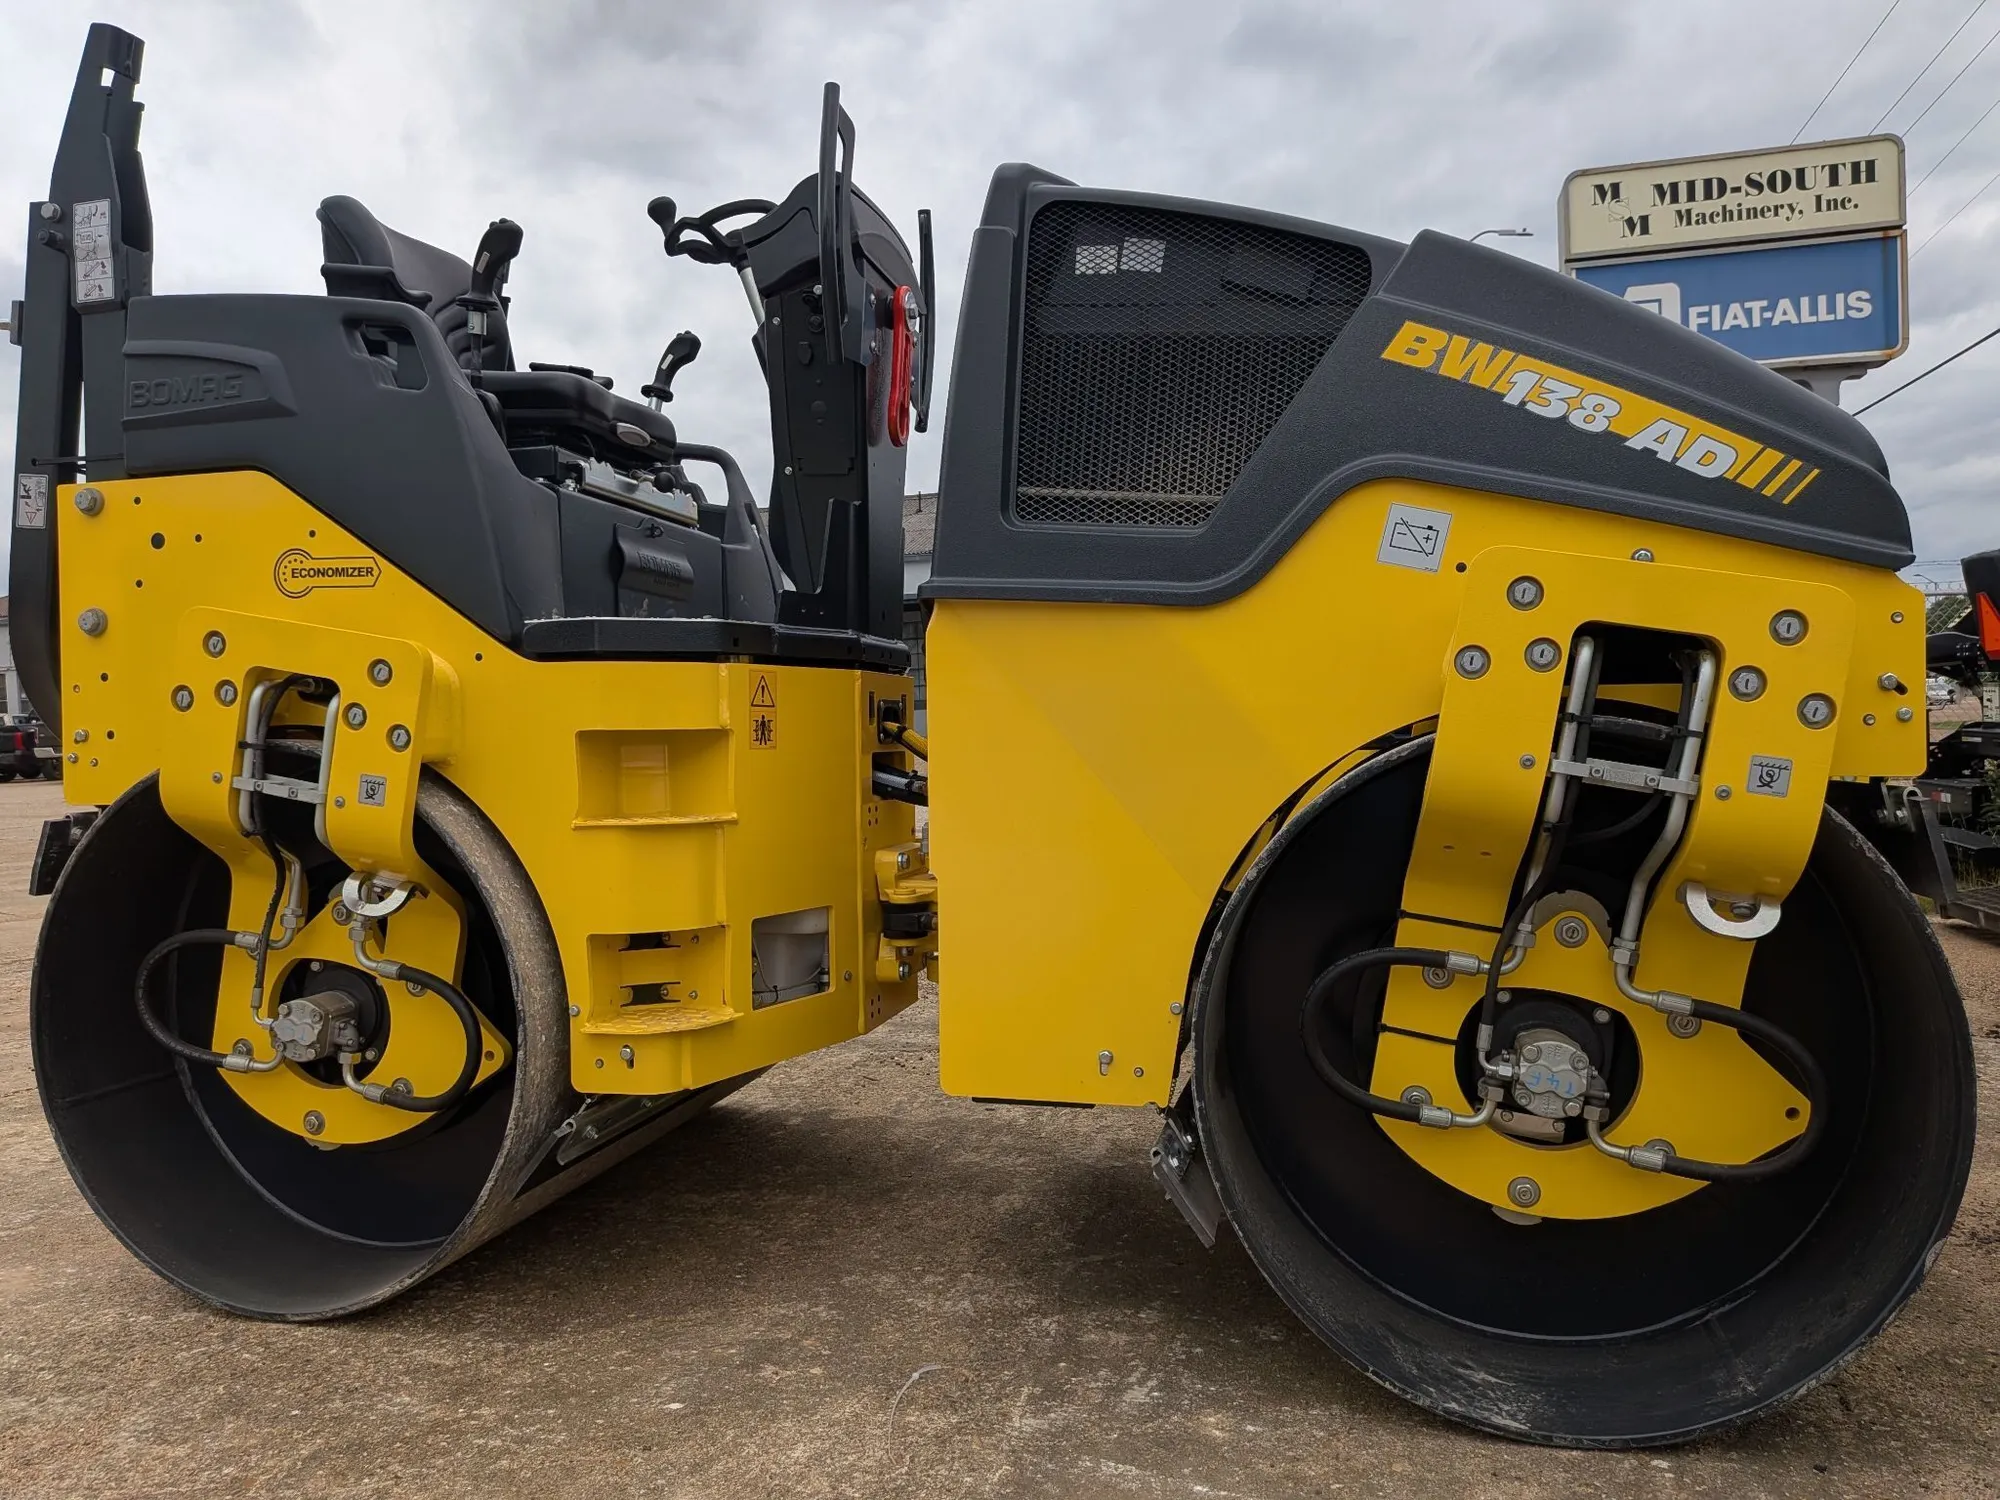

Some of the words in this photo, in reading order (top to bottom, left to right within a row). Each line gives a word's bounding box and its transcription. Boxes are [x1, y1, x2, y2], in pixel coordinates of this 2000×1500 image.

[1651, 158, 1879, 207] MID-SOUTH
[1673, 200, 1804, 228] Machinery,
[1813, 193, 1860, 214] Inc.
[1687, 290, 1873, 332] FIAT-ALLIS
[130, 372, 244, 408] BOMAG
[1624, 417, 1738, 479] AD
[291, 567, 375, 578] ECONOMIZER
